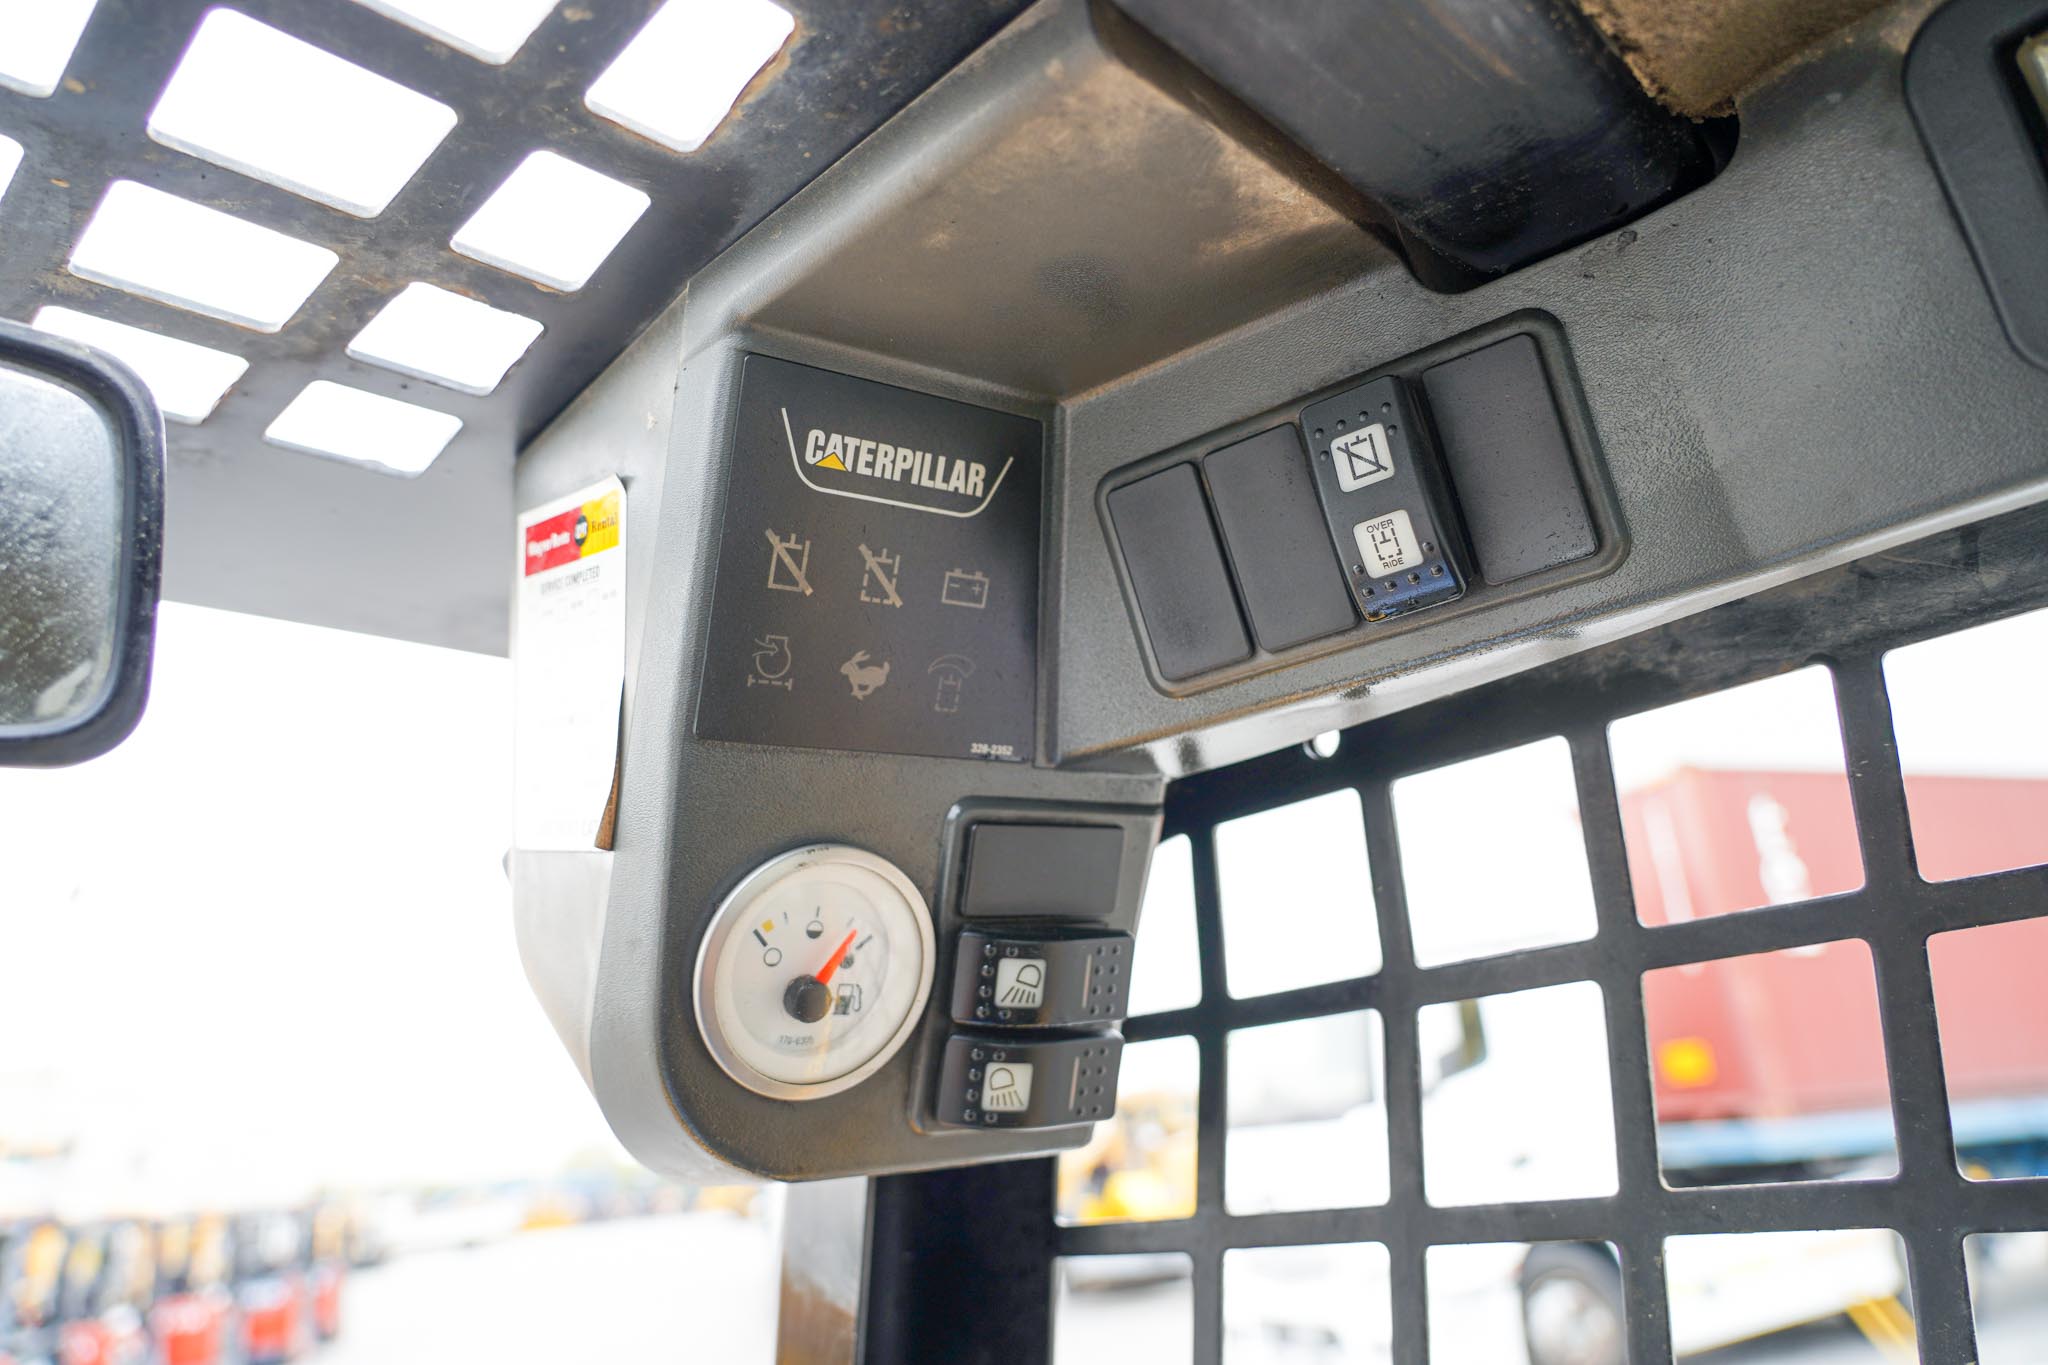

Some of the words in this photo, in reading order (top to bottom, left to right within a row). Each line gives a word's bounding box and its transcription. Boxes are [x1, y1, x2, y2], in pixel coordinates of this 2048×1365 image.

[805, 429, 986, 498] CATERPILLAR
[1366, 519, 1394, 533] OVER
[1382, 557, 1404, 569] RIDE
